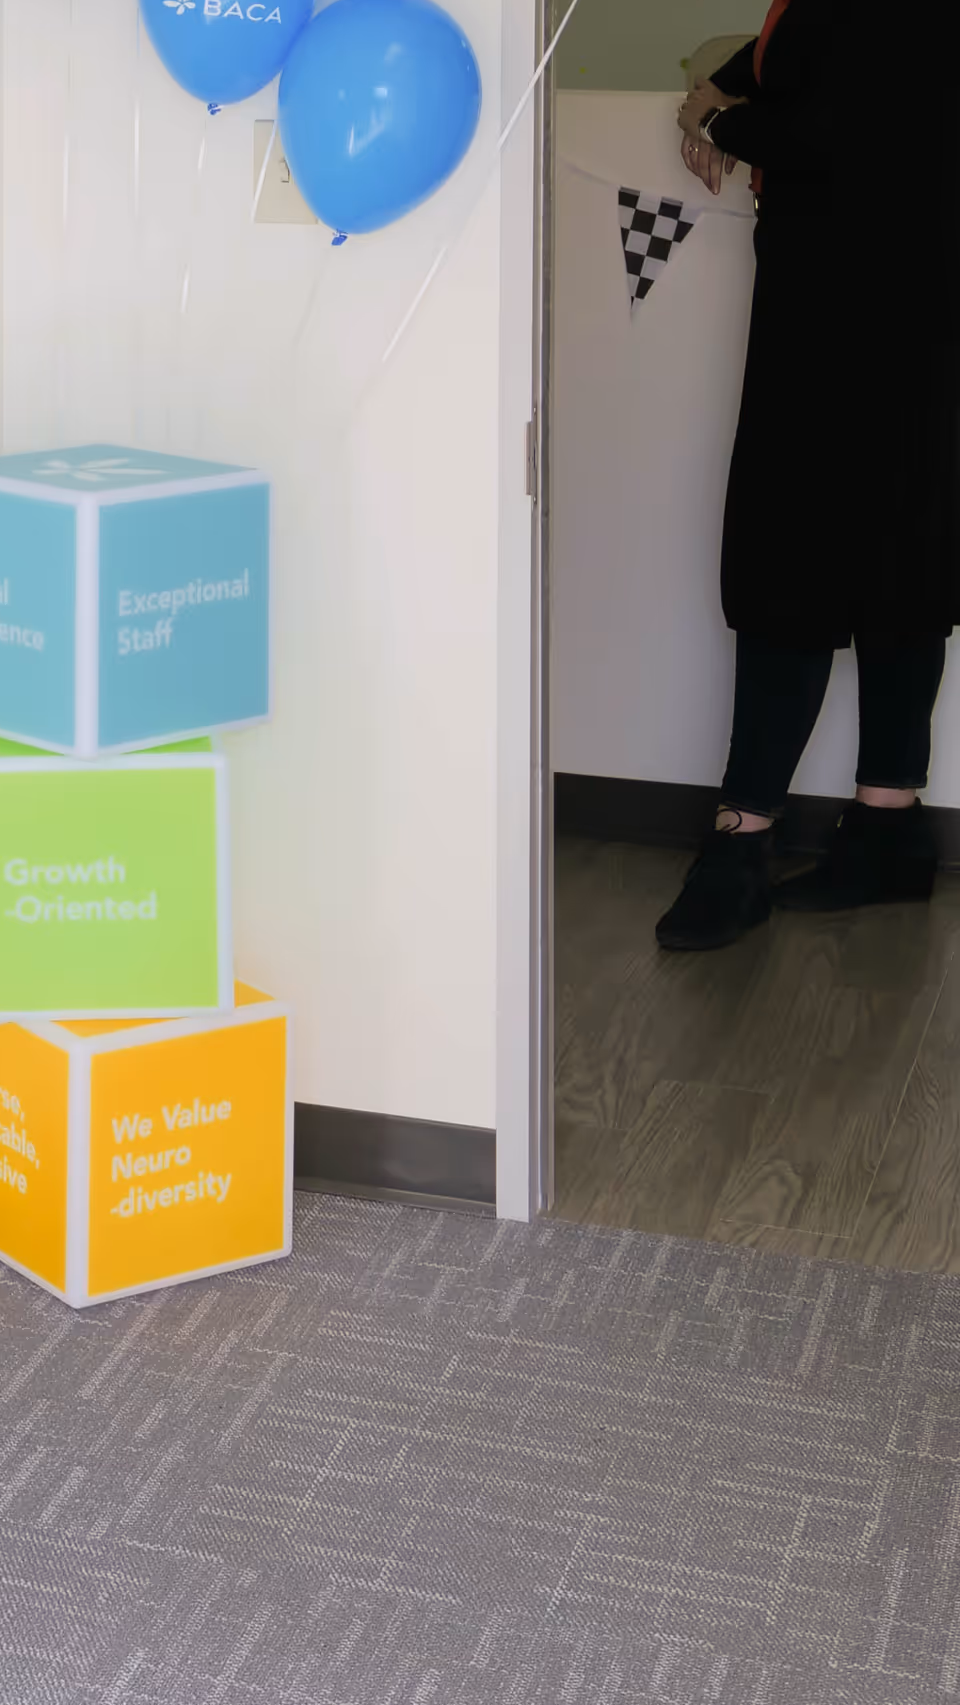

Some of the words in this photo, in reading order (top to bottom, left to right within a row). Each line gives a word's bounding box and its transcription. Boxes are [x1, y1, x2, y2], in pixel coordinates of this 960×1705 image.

[118, 567, 249, 617] Exceptional
[118, 616, 174, 656] Staff
[4, 855, 126, 886] Growth
[4, 889, 157, 924] -Oriented
[111, 1113, 153, 1144] We
[162, 1097, 231, 1131] Value
[112, 1145, 191, 1183] Neuro
[110, 1171, 232, 1218] -diversity
